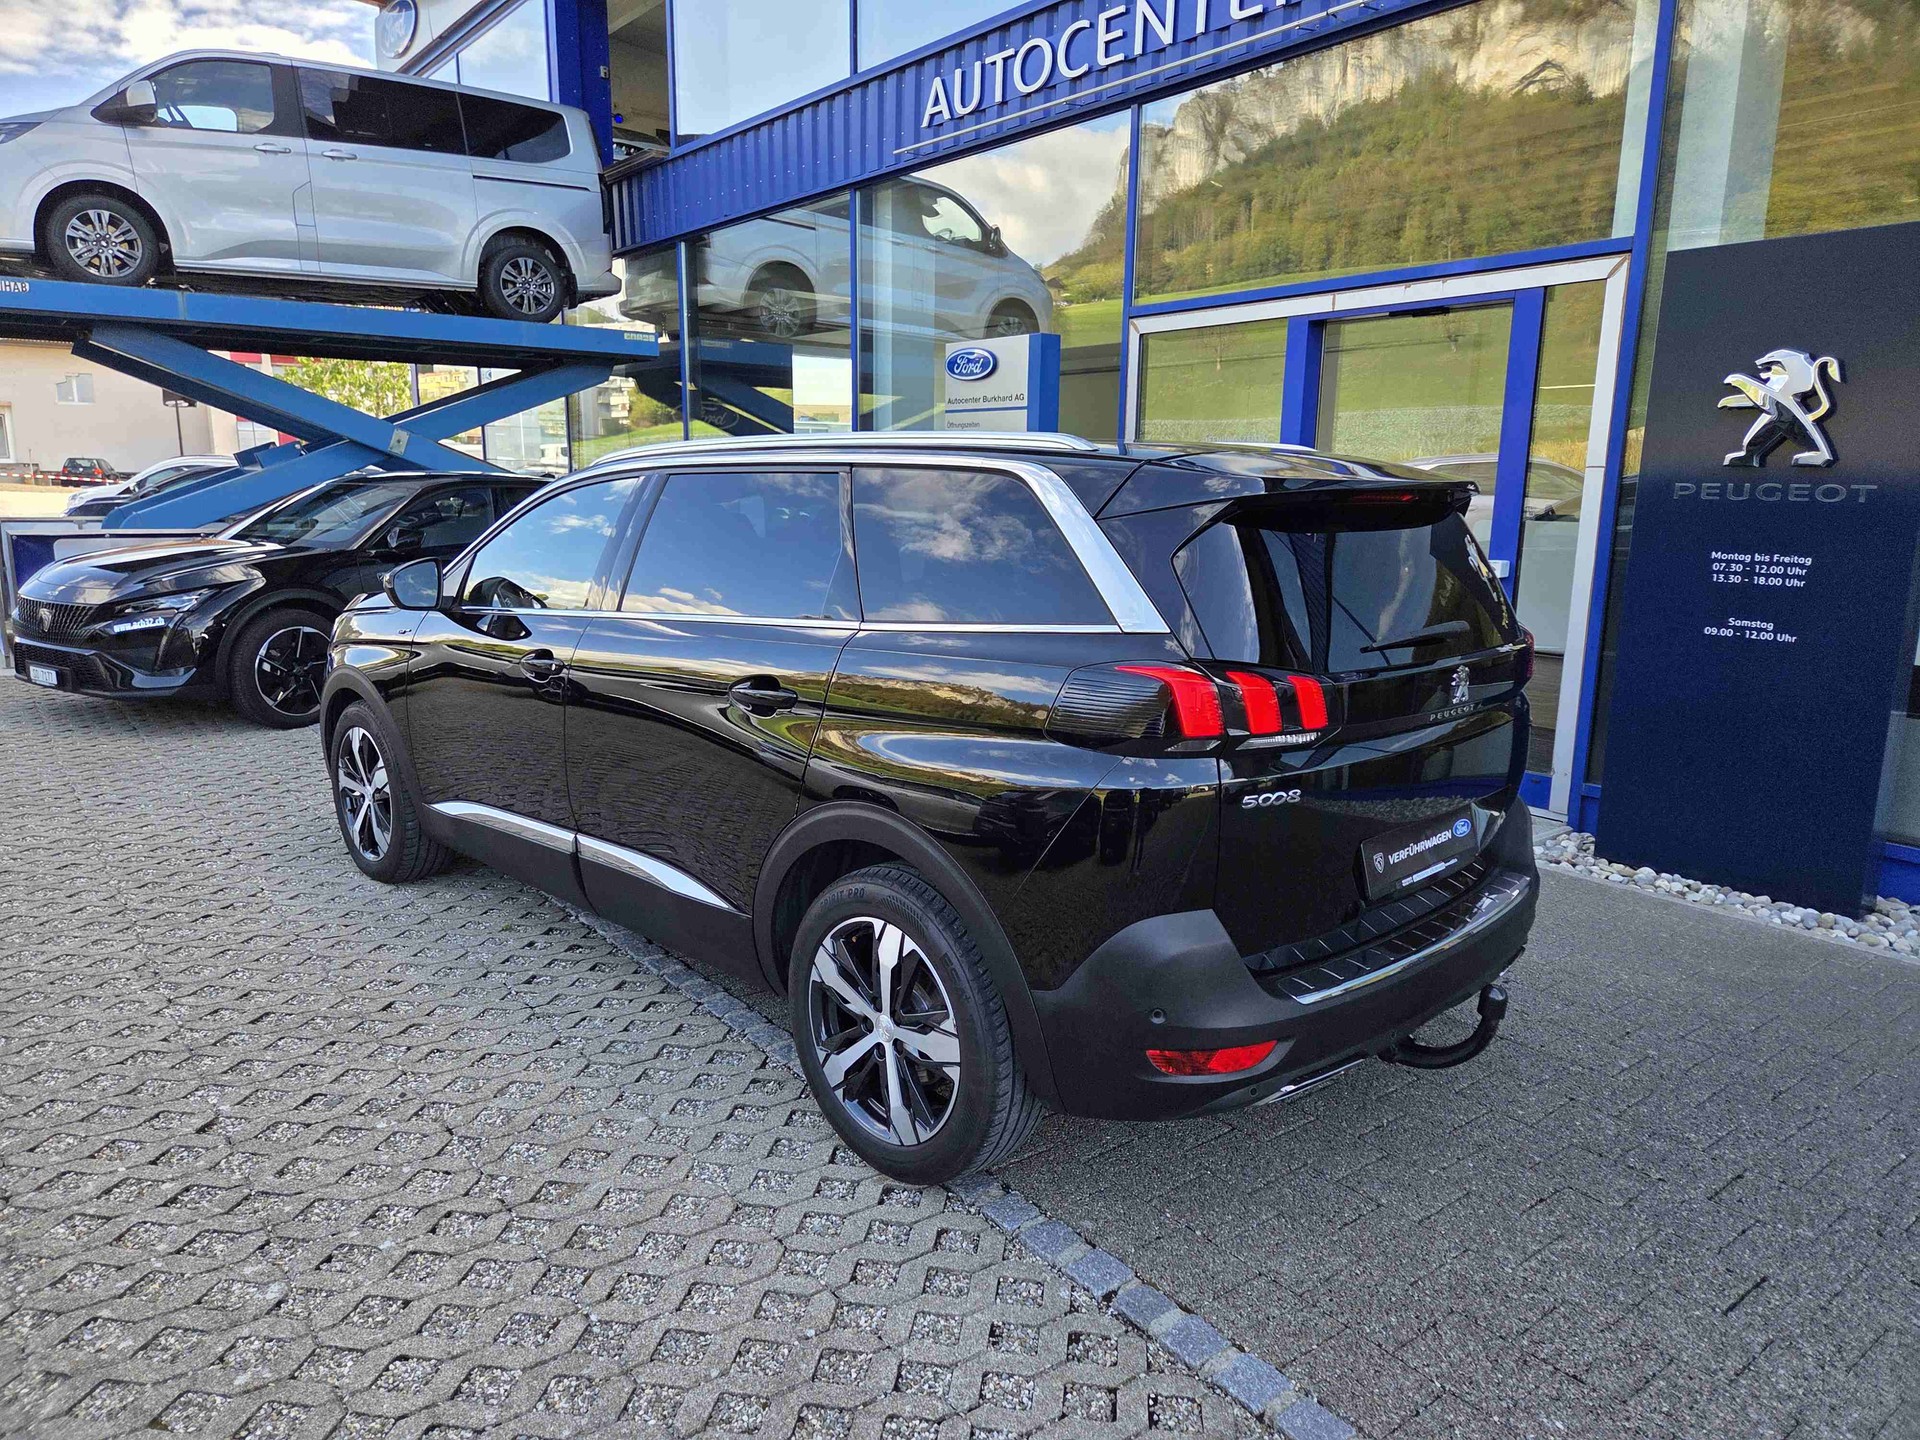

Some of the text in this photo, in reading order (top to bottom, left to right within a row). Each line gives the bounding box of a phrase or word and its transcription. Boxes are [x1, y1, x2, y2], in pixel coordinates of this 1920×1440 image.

[947, 393, 1025, 405] Autocenter Burkhard AG
[1673, 482, 1878, 503] PEUGEOT
[1711, 551, 1812, 566] Montag bis Freitag
[1712, 562, 1743, 572] 07.30
[1754, 565, 1784, 574] 12.00
[1787, 566, 1807, 576] Uhr
[1712, 573, 1742, 583] 13.30
[1753, 576, 1783, 586] 18.00
[1785, 578, 1806, 587] Uhr
[1728, 617, 1774, 631] Samstag
[1704, 626, 1734, 637] 09.00
[1745, 630, 1774, 640] 12.00
[1776, 633, 1797, 643] Uhr
[1430, 703, 1475, 721] PEUGEOT
[1241, 789, 1301, 809] 5008
[1388, 829, 1452, 865] VERFÜHRWAGEN
